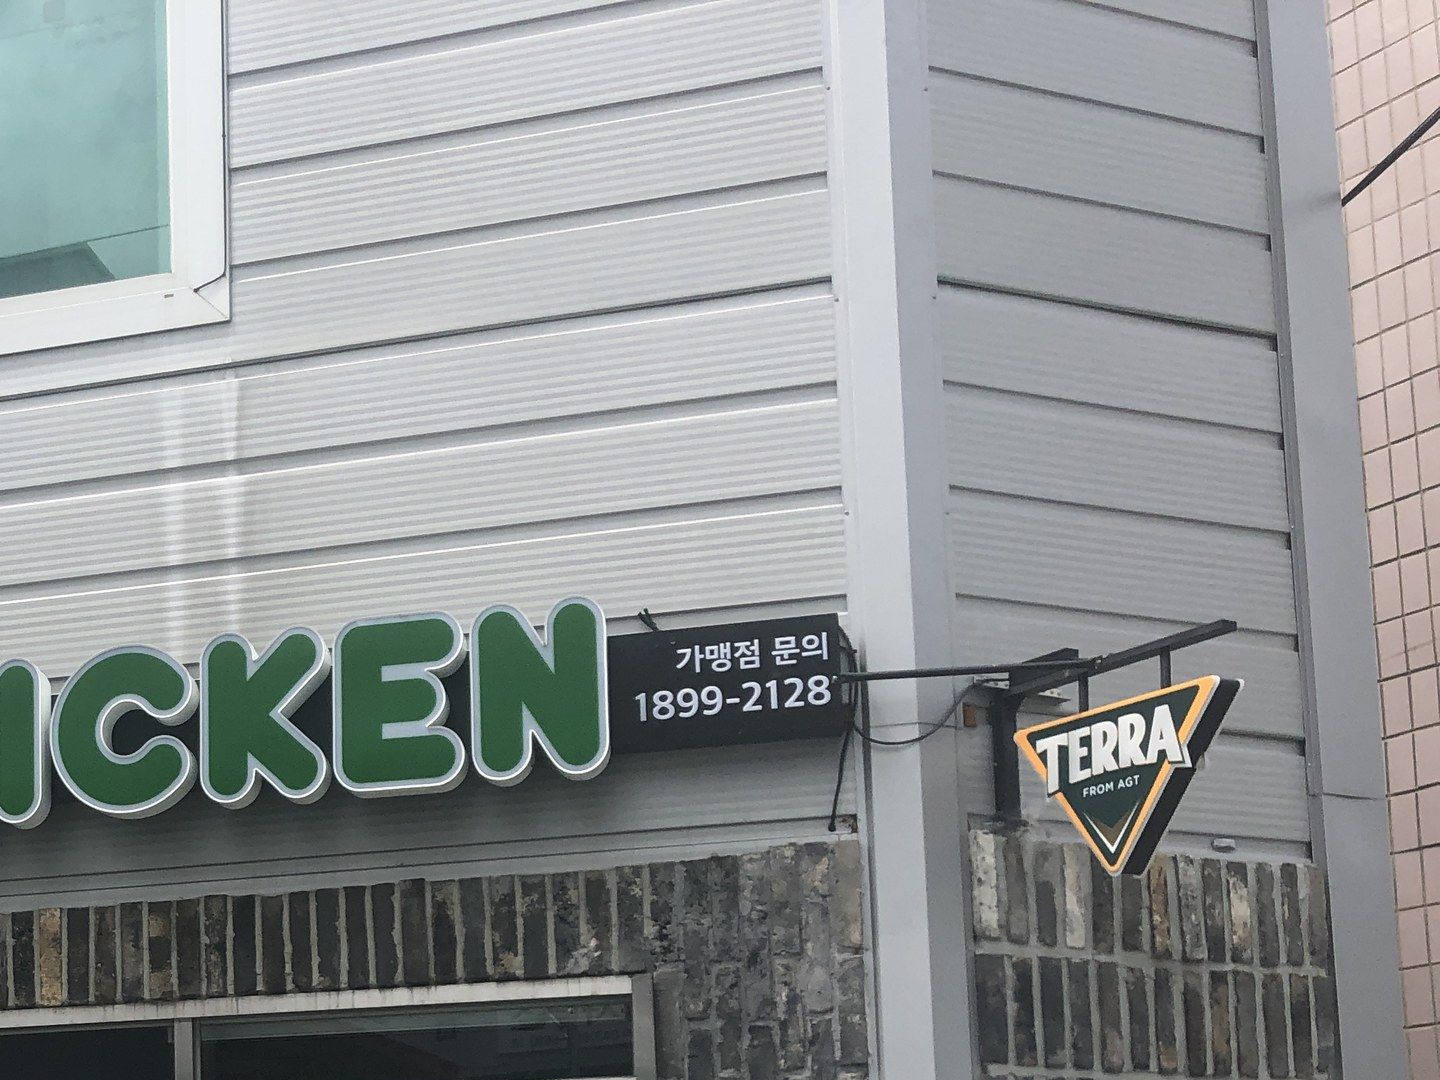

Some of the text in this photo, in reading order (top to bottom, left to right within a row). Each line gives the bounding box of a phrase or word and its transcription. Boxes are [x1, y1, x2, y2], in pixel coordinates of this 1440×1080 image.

[675, 632, 828, 673] 가맹점 문의
[634, 674, 832, 722] 1899-2128
[1035, 703, 1184, 794] TERRA
[1082, 774, 1140, 798] FROM AGT
